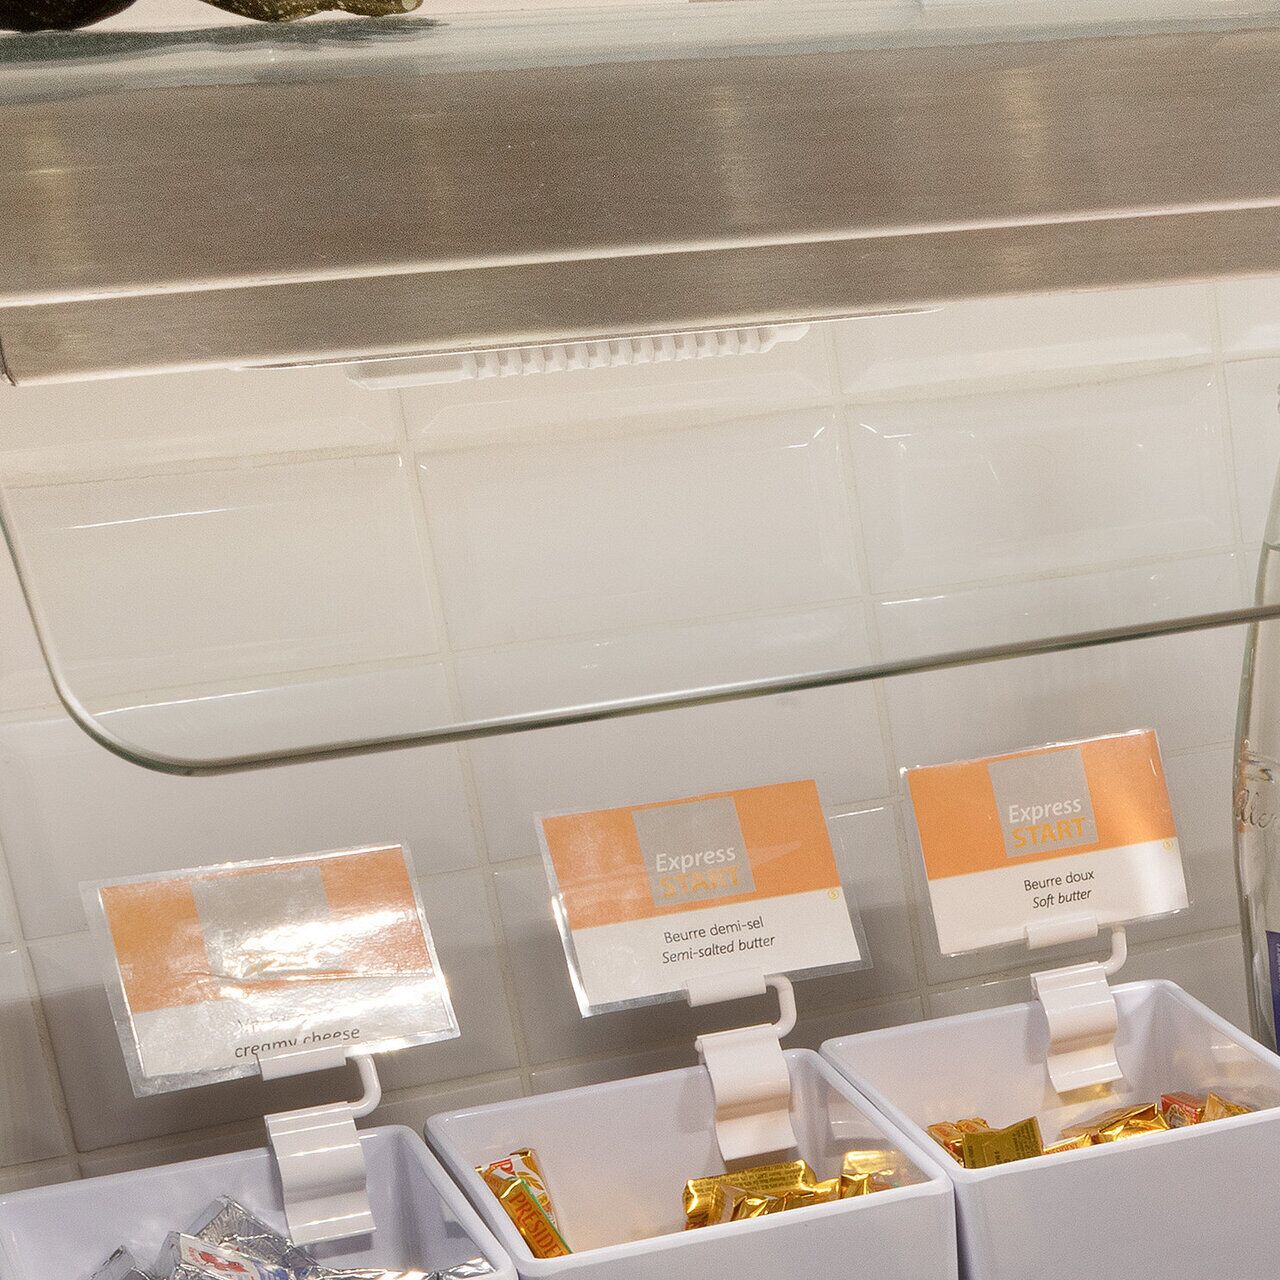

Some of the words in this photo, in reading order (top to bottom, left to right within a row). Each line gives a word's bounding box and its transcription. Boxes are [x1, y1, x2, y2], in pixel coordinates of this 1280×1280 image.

[1008, 799, 1082, 824] Express
[1012, 817, 1085, 849] START
[656, 847, 736, 873] Express
[659, 864, 740, 899] START
[1024, 876, 1062, 892] Beurre
[1066, 869, 1095, 884] doux
[1033, 894, 1055, 909] Soft
[1058, 888, 1092, 904] butter
[663, 926, 706, 944] Beurre
[709, 915, 765, 936] demi-sel
[662, 940, 735, 964] Semi-salted
[738, 935, 776, 951] butter
[234, 1037, 297, 1058] creamy
[303, 1028, 360, 1045] cheese
